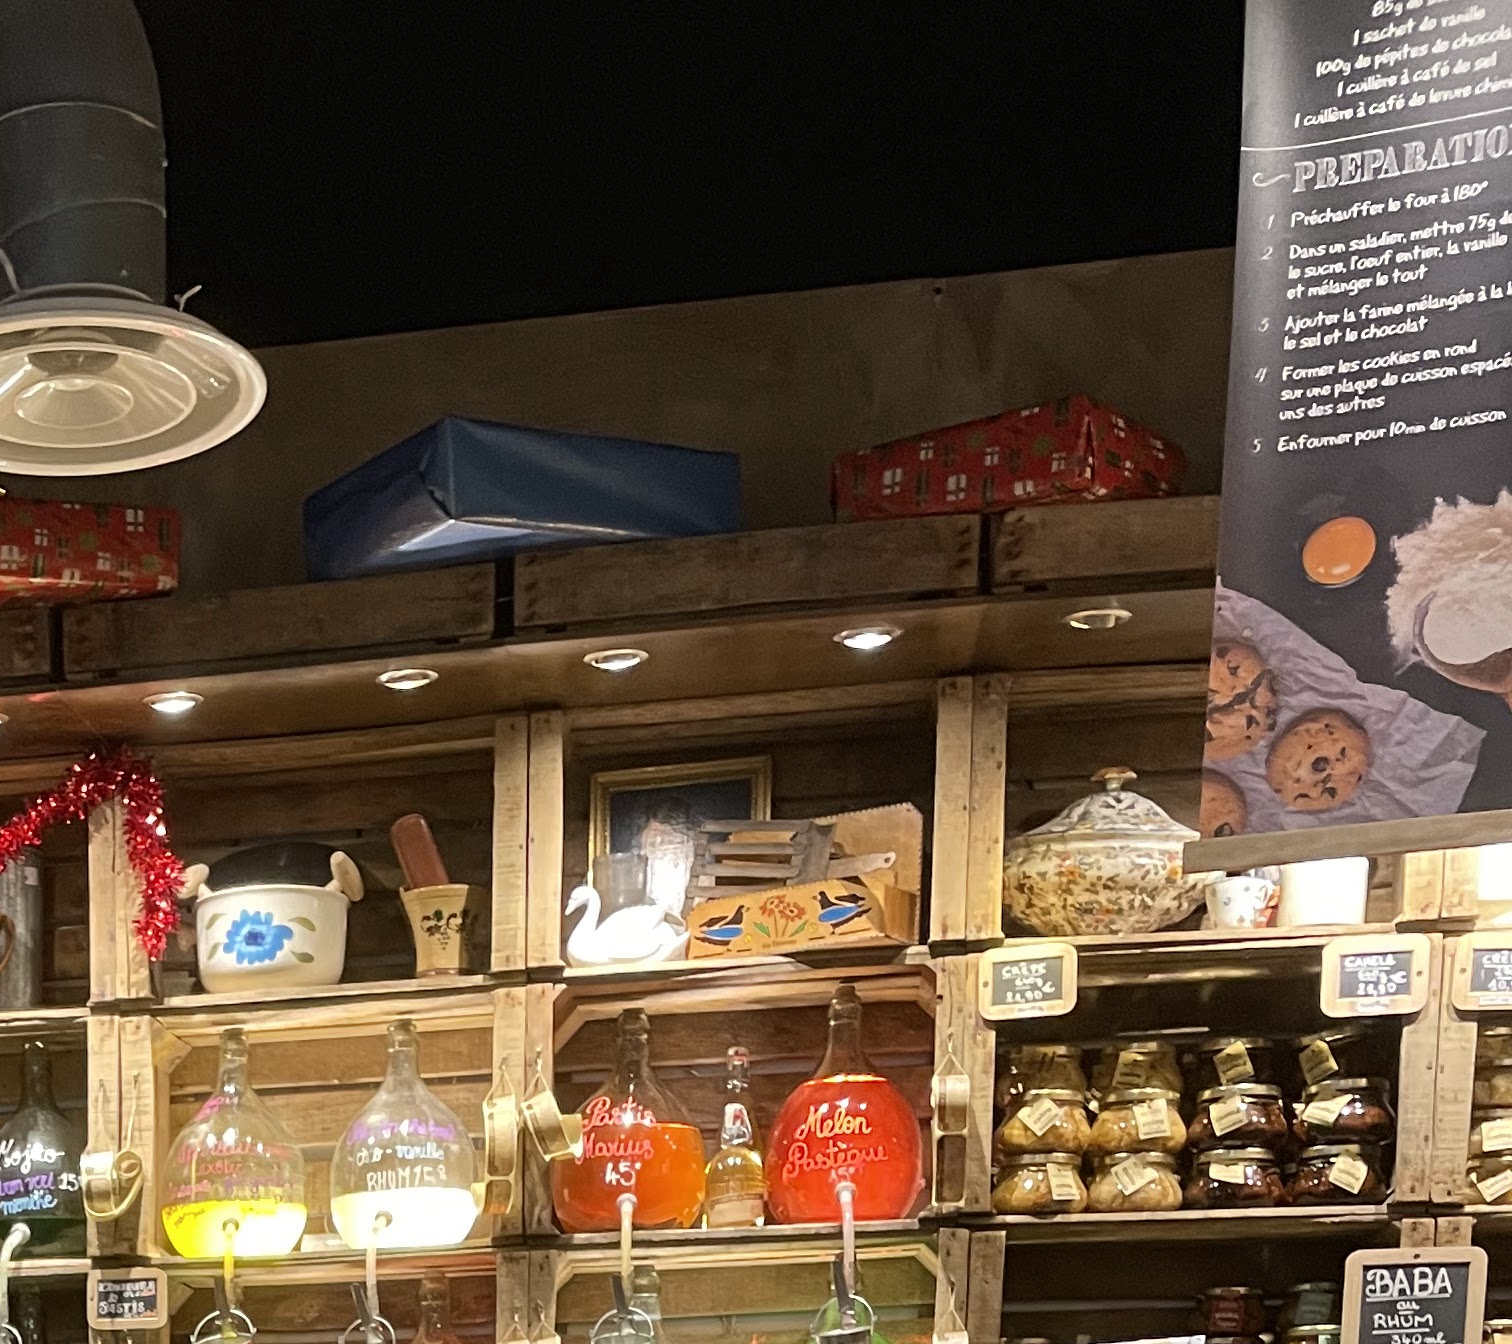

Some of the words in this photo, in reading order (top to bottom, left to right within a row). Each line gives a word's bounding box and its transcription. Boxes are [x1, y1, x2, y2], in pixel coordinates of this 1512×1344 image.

[1292, 124, 1512, 193] PREPARATIO
[1290, 200, 1385, 228] Préchauffer
[1388, 197, 1401, 212] le
[1404, 192, 1438, 209] four
[1441, 188, 1451, 203] à
[1453, 180, 1488, 201] 180°
[1288, 265, 1300, 279] le
[1304, 261, 1346, 278] sucre,
[1396, 246, 1443, 263] entier,
[1446, 240, 1460, 255] la
[1463, 231, 1508, 253] vanille
[1277, 433, 1353, 453] Enfourner
[1354, 427, 1387, 446] pour
[1429, 416, 1447, 432] de
[1449, 410, 1507, 429] cuisson
[794, 1105, 872, 1141] Melon
[1365, 1266, 1453, 1297] BABA
[1373, 1313, 1433, 1328] RHUM
